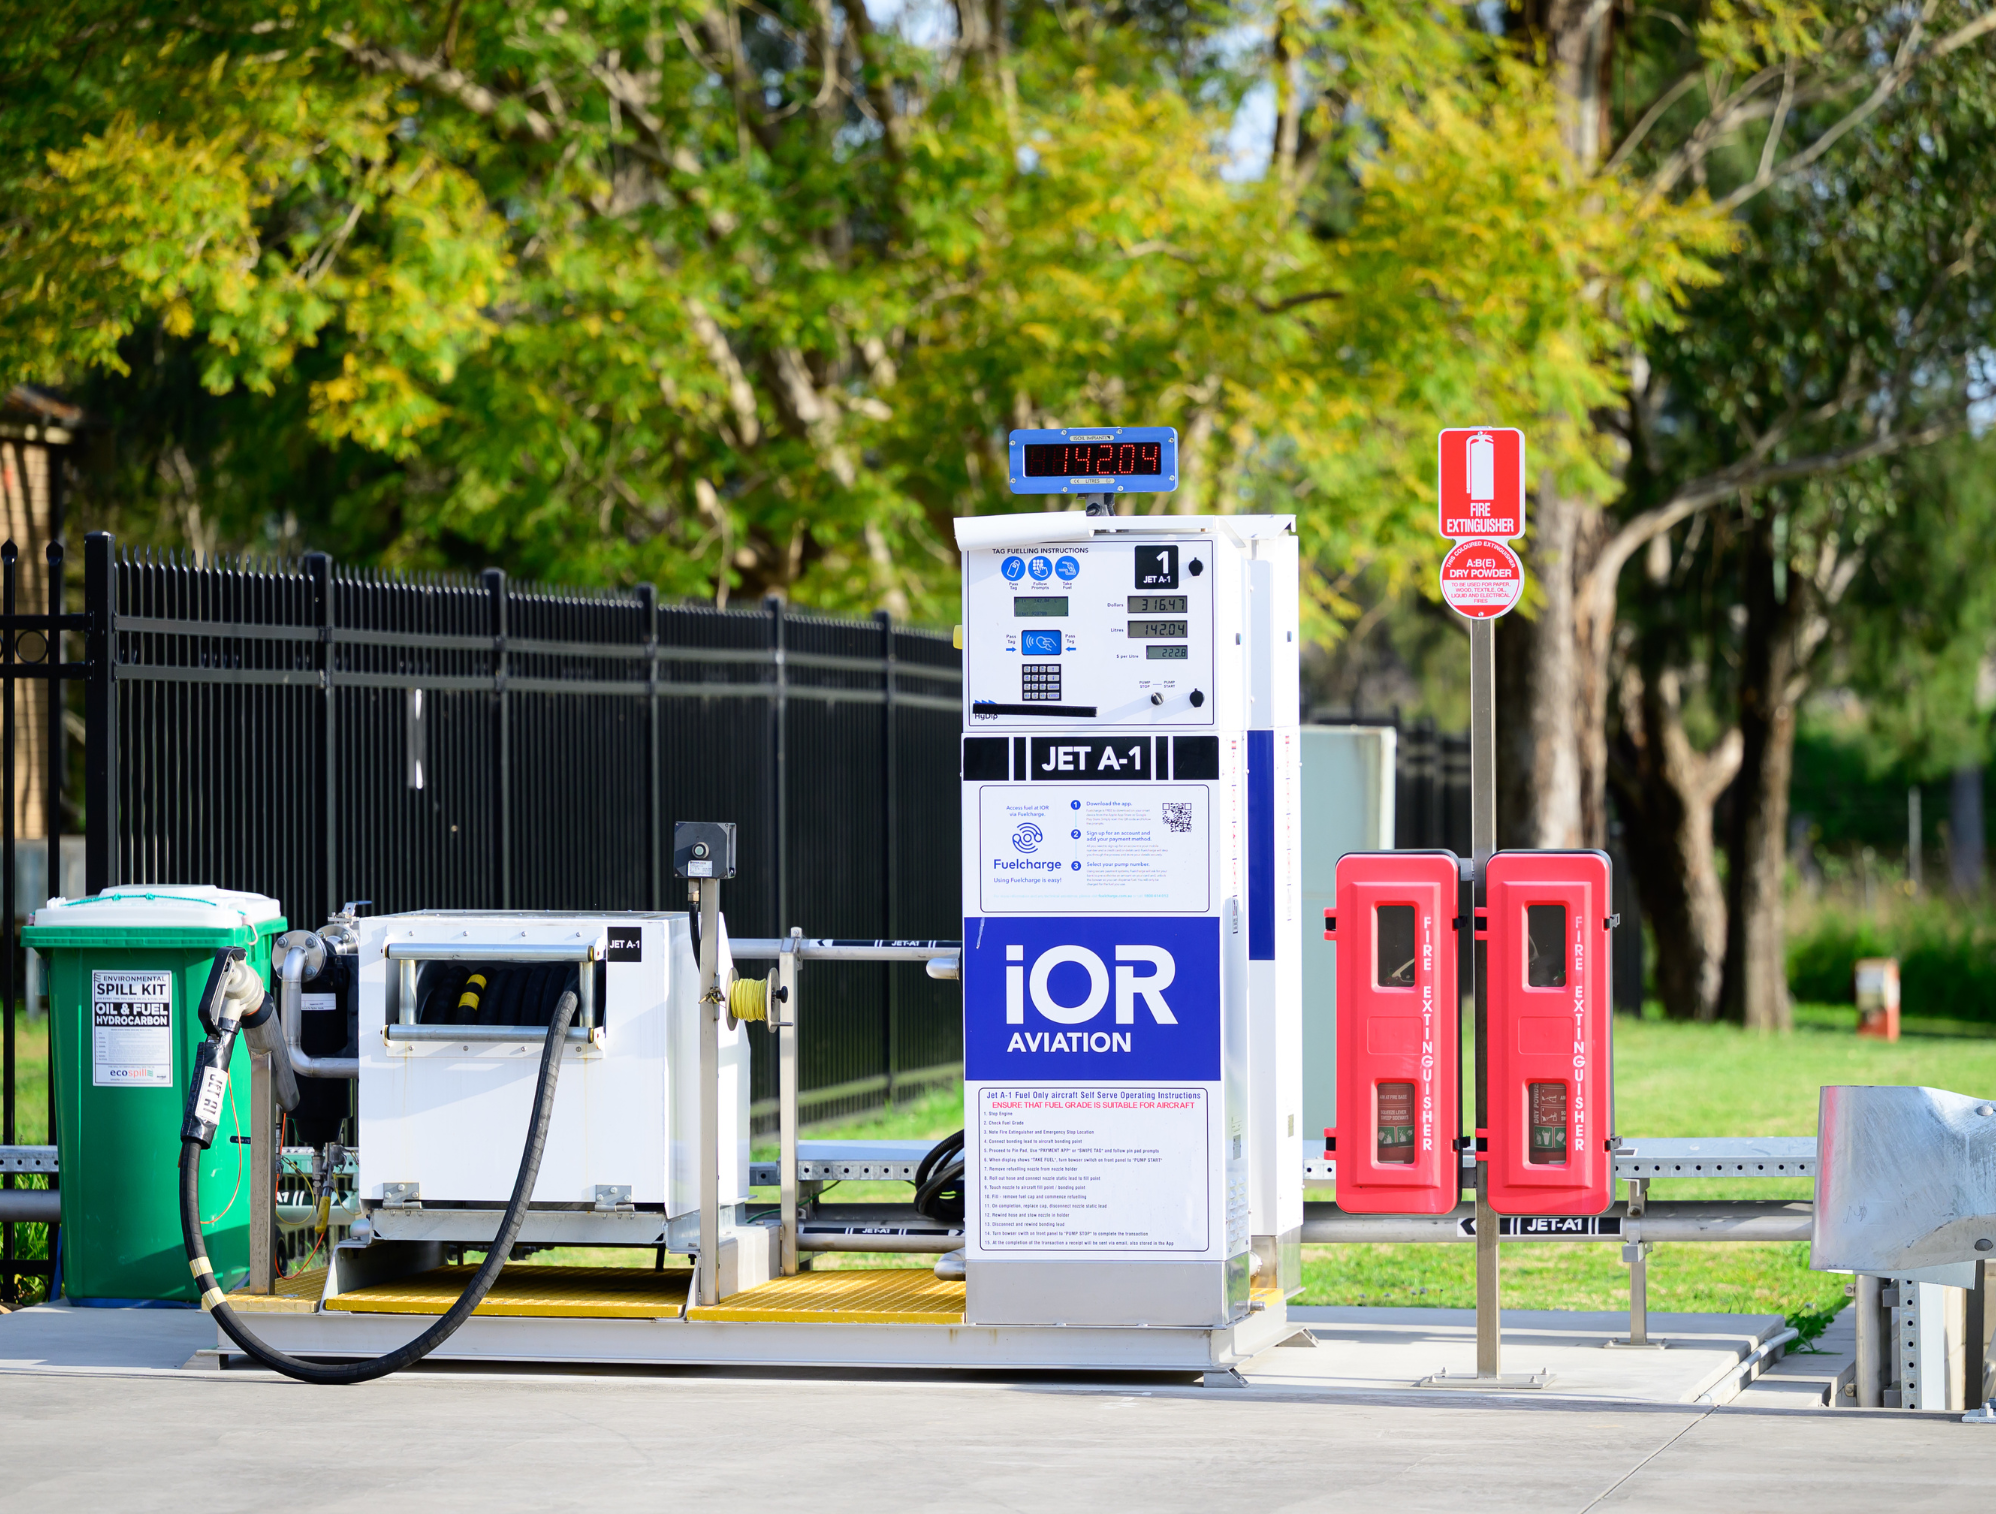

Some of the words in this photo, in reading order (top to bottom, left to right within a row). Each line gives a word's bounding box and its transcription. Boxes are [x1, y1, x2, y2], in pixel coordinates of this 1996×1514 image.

[1064, 444, 1158, 474] 142.04
[1470, 502, 1491, 517] FIRE
[1446, 518, 1514, 533] EXTINGUISHER
[1446, 556, 1456, 568] THIS
[1454, 541, 1482, 557] COLOURED
[1484, 541, 1515, 568] EXTINGUISHER
[1156, 551, 1169, 574] 1
[1466, 558, 1496, 568] A:B(E)
[1143, 575, 1157, 584] JET
[1158, 575, 1171, 583] A-1
[1449, 569, 1469, 578] DRY
[1471, 568, 1512, 578] POWDER
[1140, 598, 1185, 611] 316.47
[1145, 623, 1185, 636] 142.04
[1162, 648, 1186, 658] 222.8
[1041, 746, 1092, 771] JET
[1097, 745, 1141, 770] A-1
[994, 858, 1062, 872] Fuelcharge
[609, 940, 625, 948] JET
[626, 940, 640, 948] A-1
[1423, 916, 1432, 971] FIRE
[1575, 916, 1583, 971] FIRE
[97, 983, 137, 995] SPILL
[142, 984, 166, 995] KIT
[1006, 945, 1179, 1025] iOR
[96, 1003, 118, 1015] OIL
[120, 1003, 130, 1015] &
[133, 1003, 168, 1015] FUEL
[96, 1016, 167, 1026] HYDROCARBON
[1007, 1032, 1131, 1053] AVIATION
[110, 1069, 146, 1078] ecospill
[1422, 986, 1433, 1151] EXTINGUISHER
[1573, 986, 1585, 1151] EXTINGUISHER
[986, 1091, 998, 1099] Jet
[1000, 1091, 1012, 1099] A-1
[1015, 1091, 1030, 1099] Fuel
[1033, 1091, 1049, 1100] Only
[1051, 1091, 1078, 1099] aircraft
[1080, 1091, 1095, 1099] Self
[1097, 1091, 1118, 1099] Serve
[1120, 1091, 1156, 1100] Operating
[992, 1101, 1022, 1109] ENSURE
[1044, 1101, 1063, 1109] FUEL
[1064, 1101, 1092, 1109] GRADE
[1093, 1101, 1101, 1109] IS
[1102, 1101, 1138, 1109] SUITABLE
[1139, 1101, 1155, 1109] FOR
[1527, 1218, 1582, 1231] JET-A1
